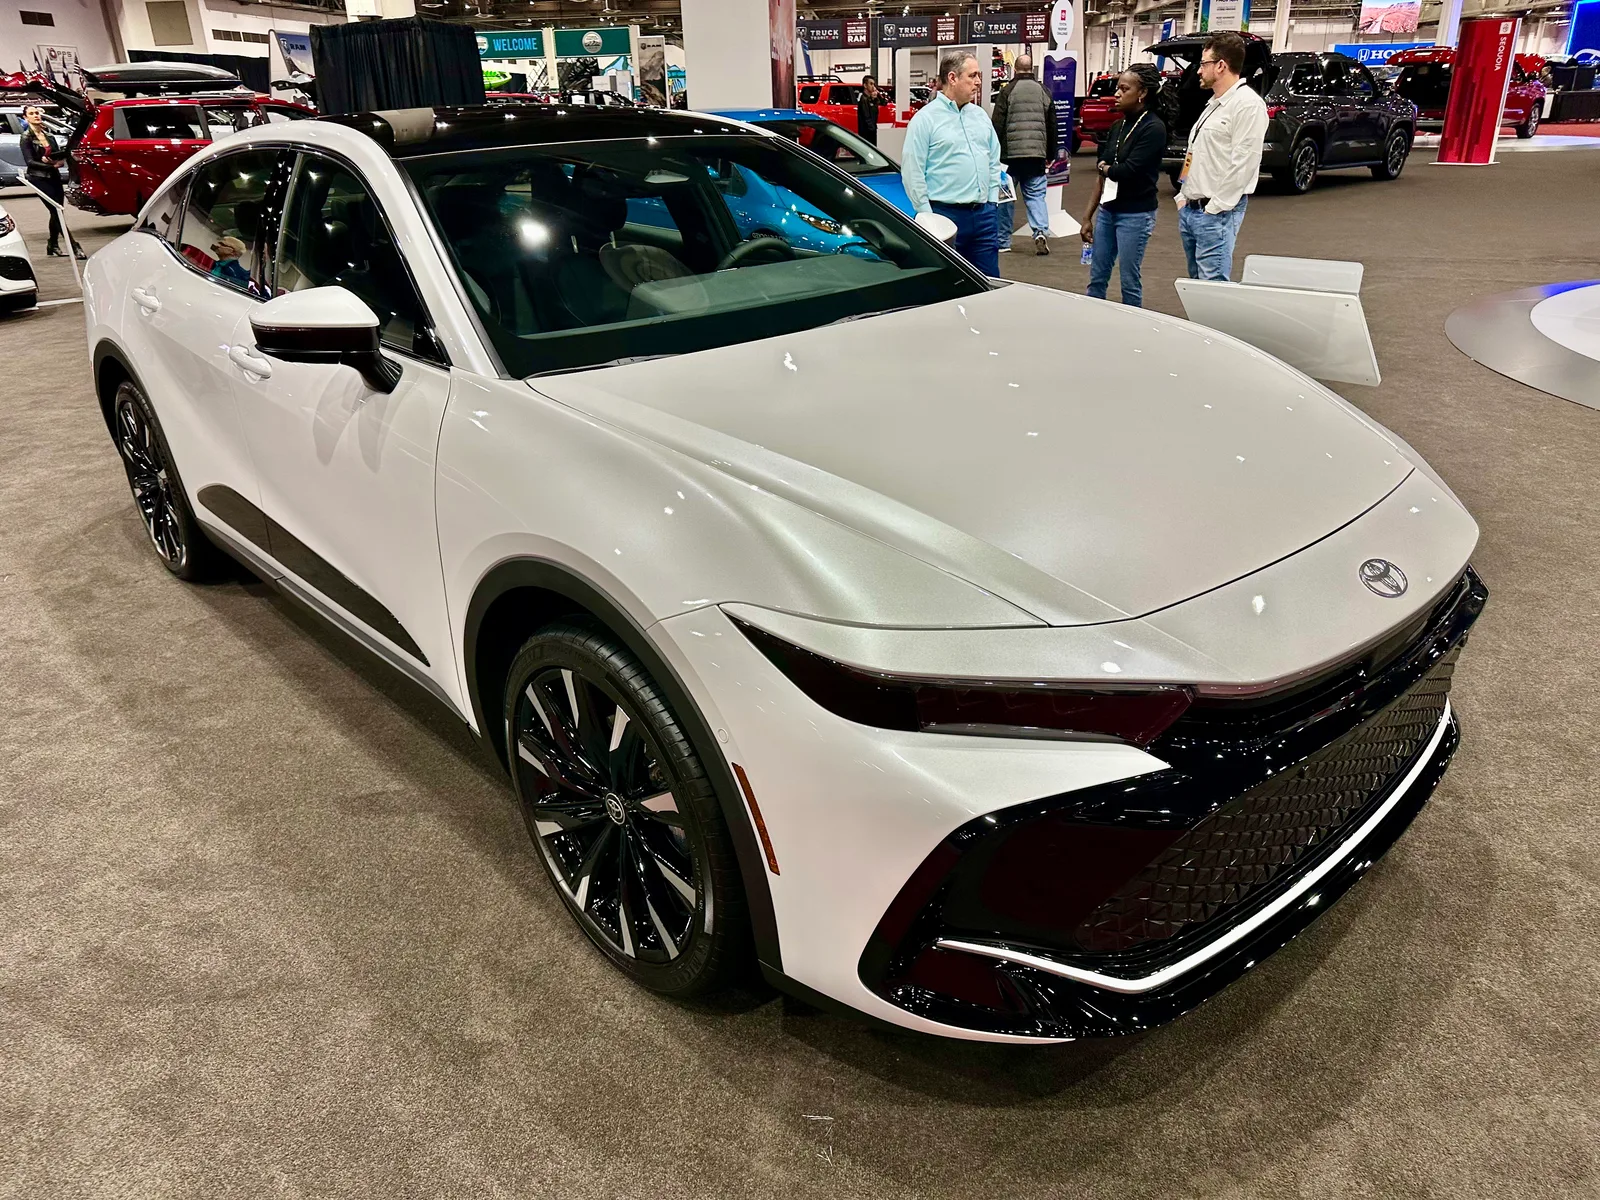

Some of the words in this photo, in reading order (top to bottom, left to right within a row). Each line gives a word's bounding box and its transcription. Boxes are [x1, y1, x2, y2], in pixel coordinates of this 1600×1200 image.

[848, 35, 867, 43] RAM
[289, 43, 307, 51] RAM
[493, 38, 538, 51] WELCOME
[1494, 36, 1507, 71] SEQUOIA
